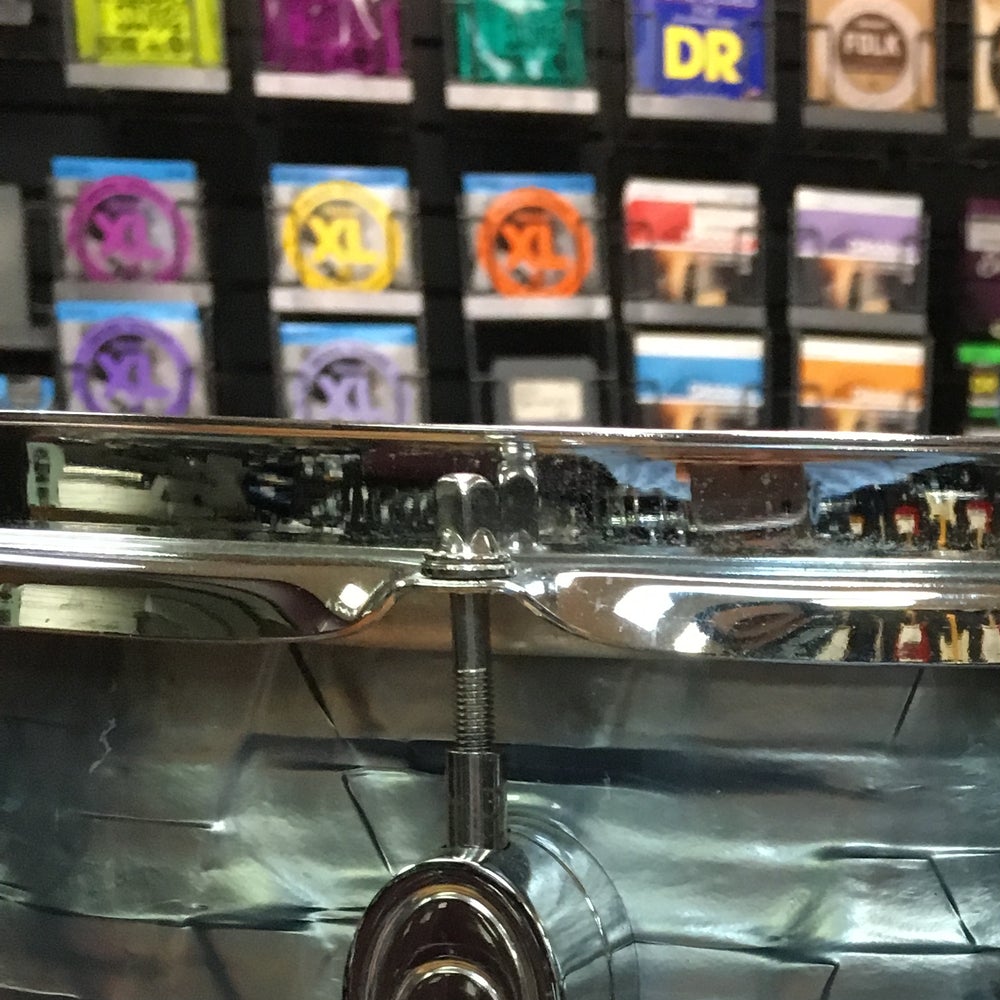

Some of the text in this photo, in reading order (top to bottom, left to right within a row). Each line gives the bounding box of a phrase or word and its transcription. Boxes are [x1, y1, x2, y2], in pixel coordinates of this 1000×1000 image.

[663, 24, 744, 85] DR
[94, 212, 165, 263] XL
[308, 215, 379, 266] XL
[502, 223, 570, 271] XL
[97, 352, 171, 402] XL
[319, 375, 385, 421] XL
